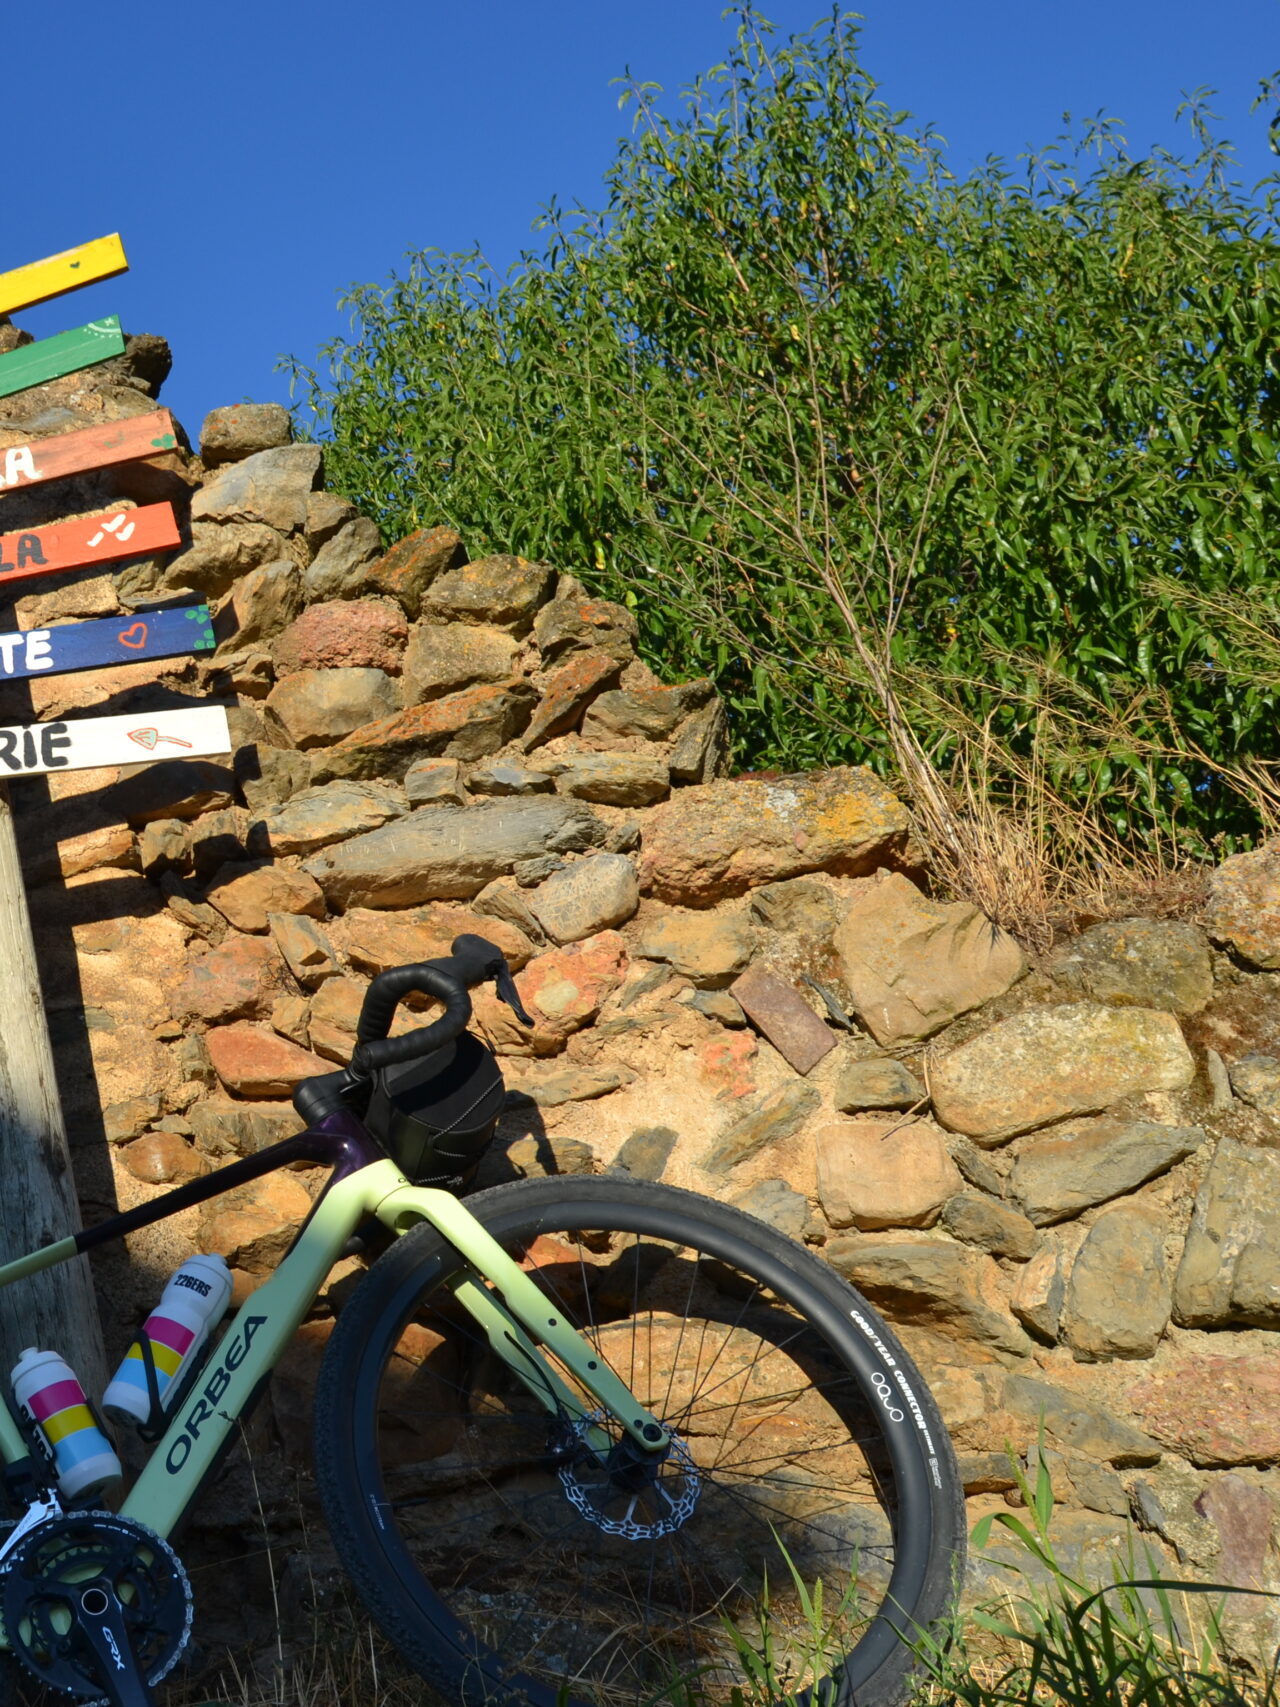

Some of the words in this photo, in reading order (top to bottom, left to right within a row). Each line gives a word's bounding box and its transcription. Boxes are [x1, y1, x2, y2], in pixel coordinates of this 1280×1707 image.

[174, 1274, 213, 1297] 226ERS
[165, 1315, 269, 1475] ORBEA
[871, 1372, 904, 1422] OQUO
[894, 1370, 927, 1429] CONNECTOR
[102, 1626, 126, 1671] GRX
